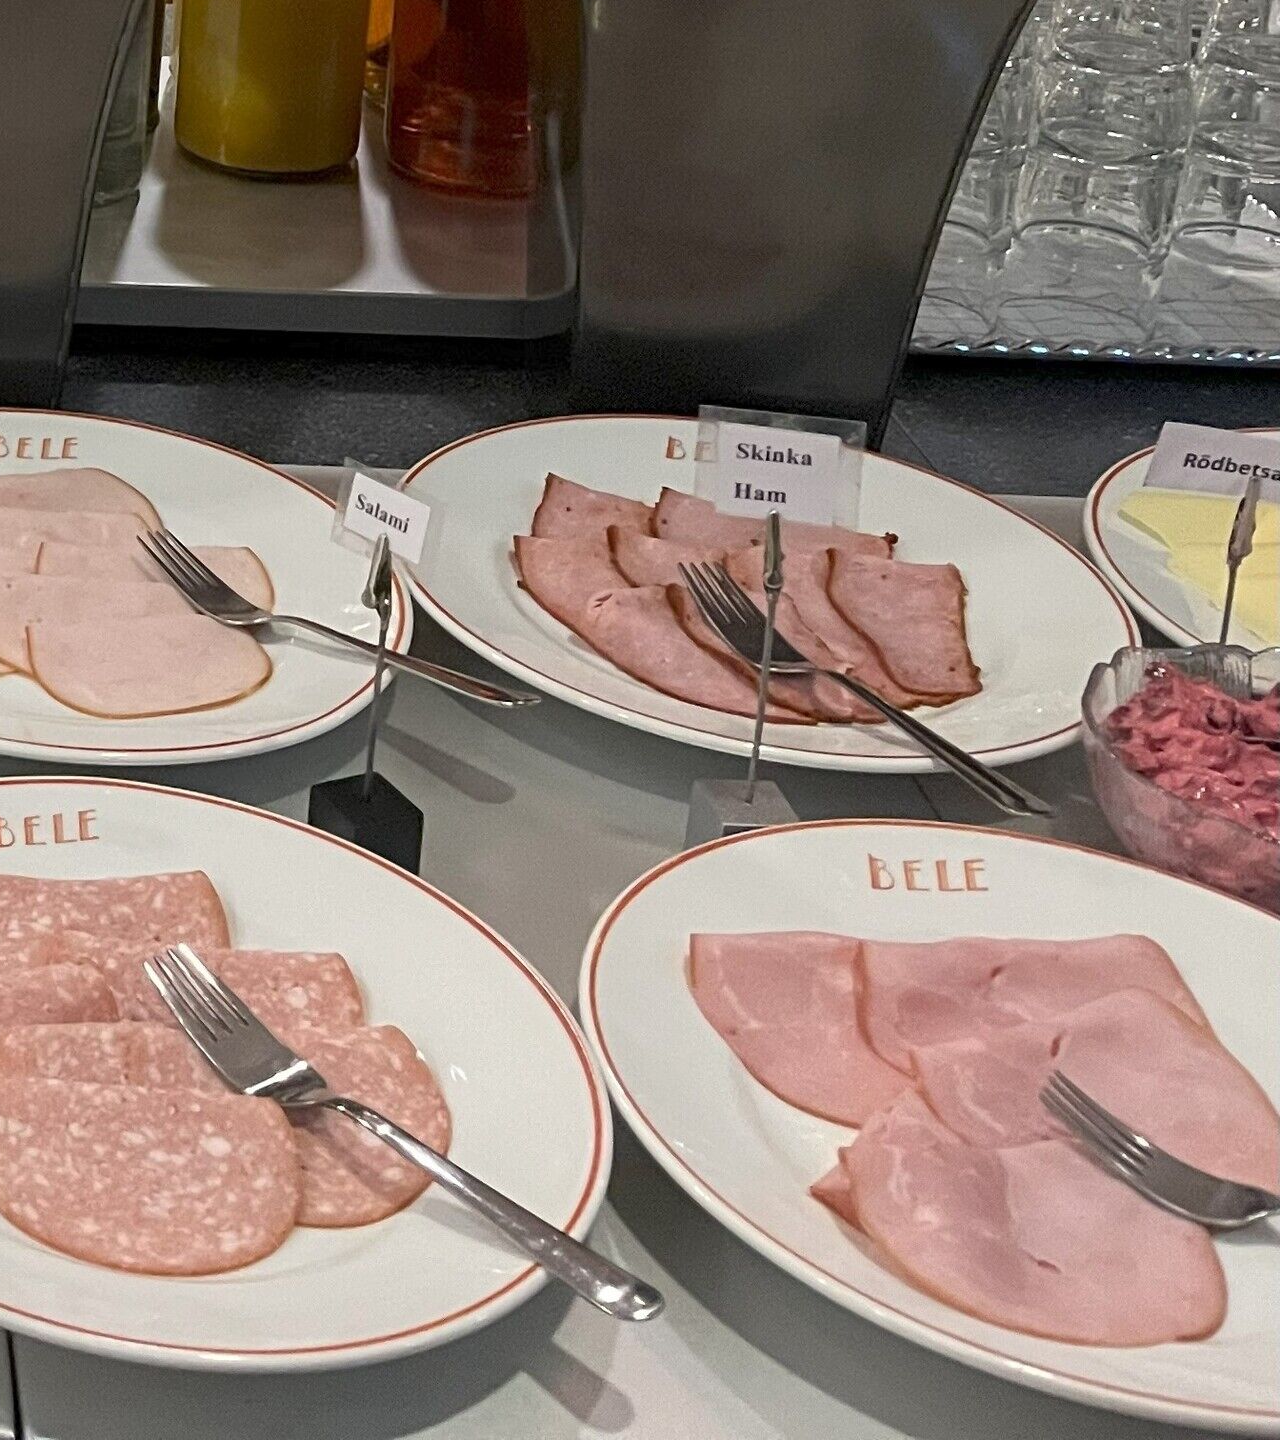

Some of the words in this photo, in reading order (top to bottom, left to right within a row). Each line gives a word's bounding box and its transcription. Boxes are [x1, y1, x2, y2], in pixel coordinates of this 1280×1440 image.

[737, 442, 813, 466] Skinka
[734, 482, 787, 504] Ham
[355, 493, 410, 533] Salami
[867, 852, 989, 891] BELE
